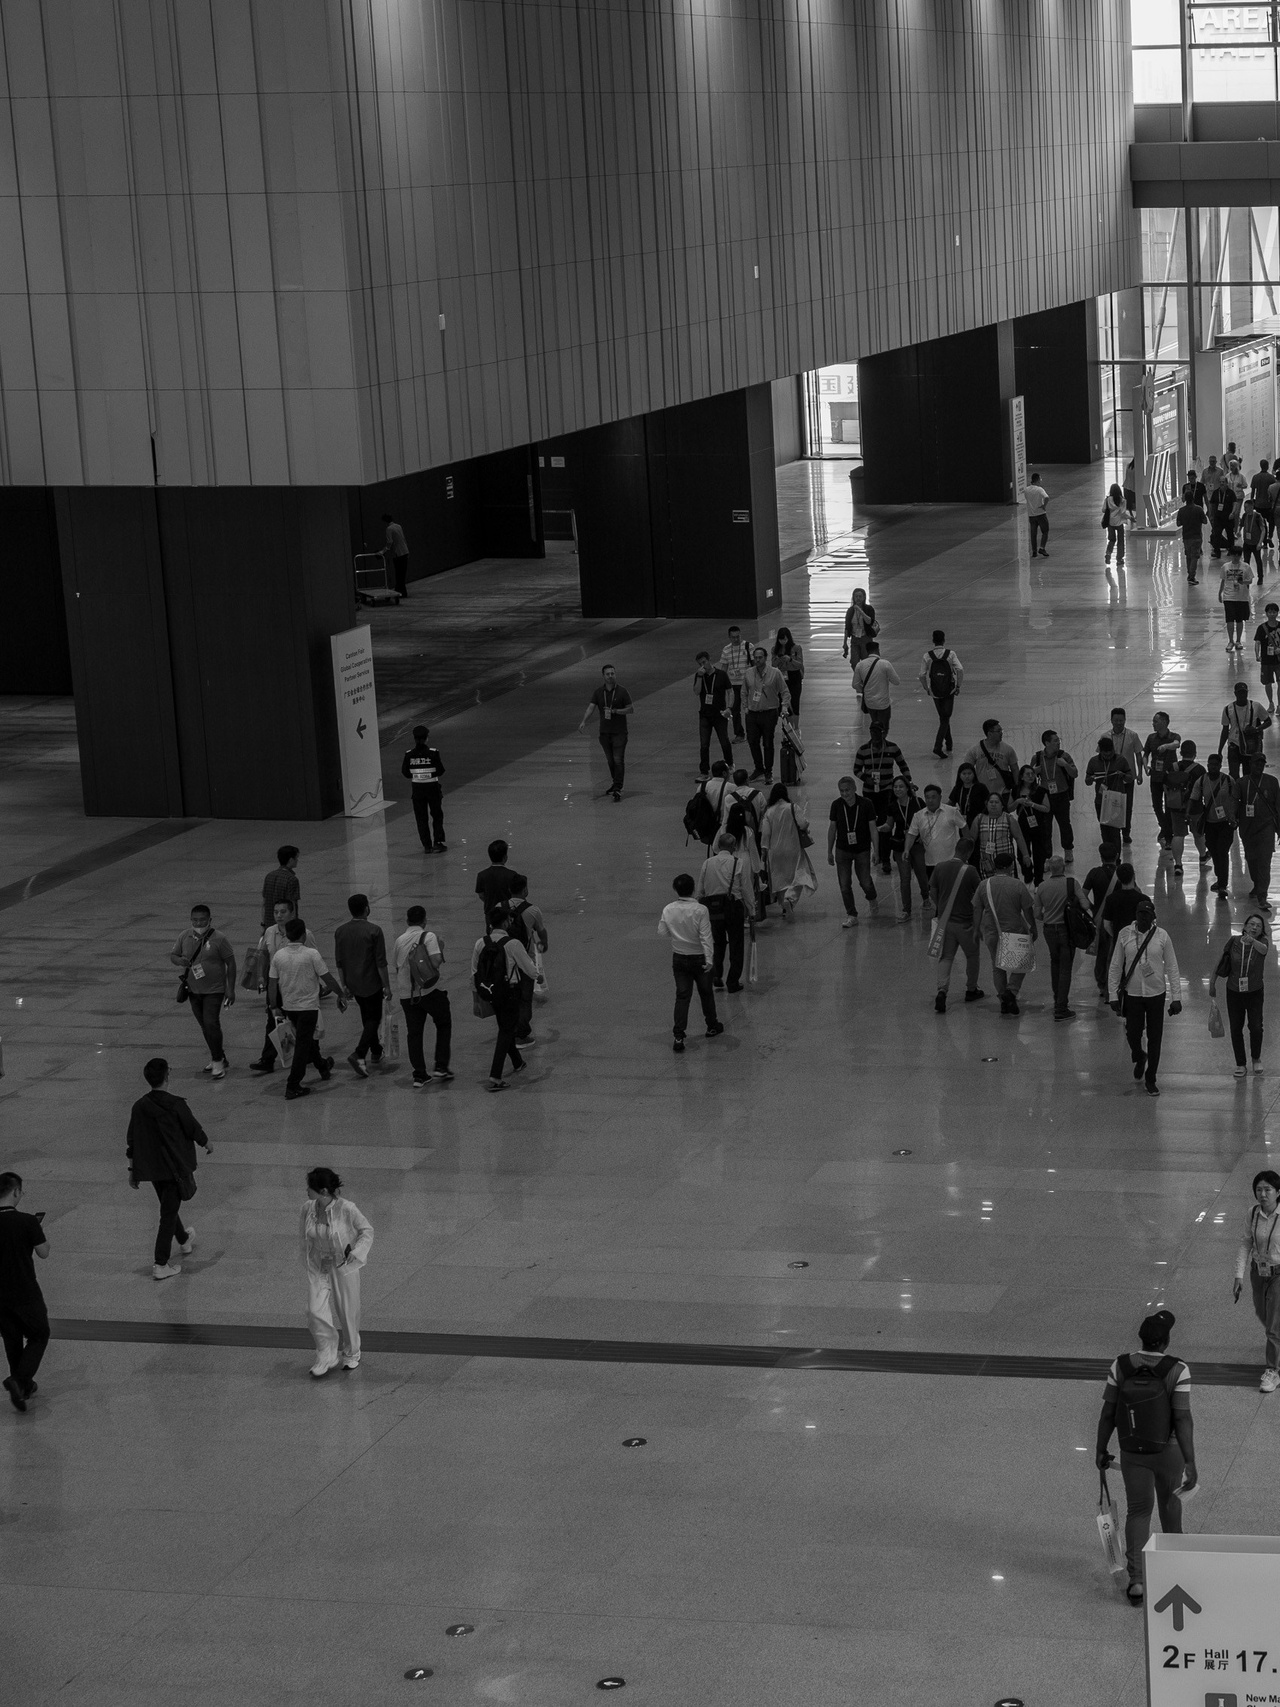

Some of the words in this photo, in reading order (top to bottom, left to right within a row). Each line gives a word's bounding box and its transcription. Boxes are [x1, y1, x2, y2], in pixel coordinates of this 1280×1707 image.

[1162, 1644, 1196, 1670] 2F
[1204, 1648, 1229, 1660] Hall
[1203, 1660, 1229, 1671] 展厅
[1245, 1693, 1267, 1703] New
